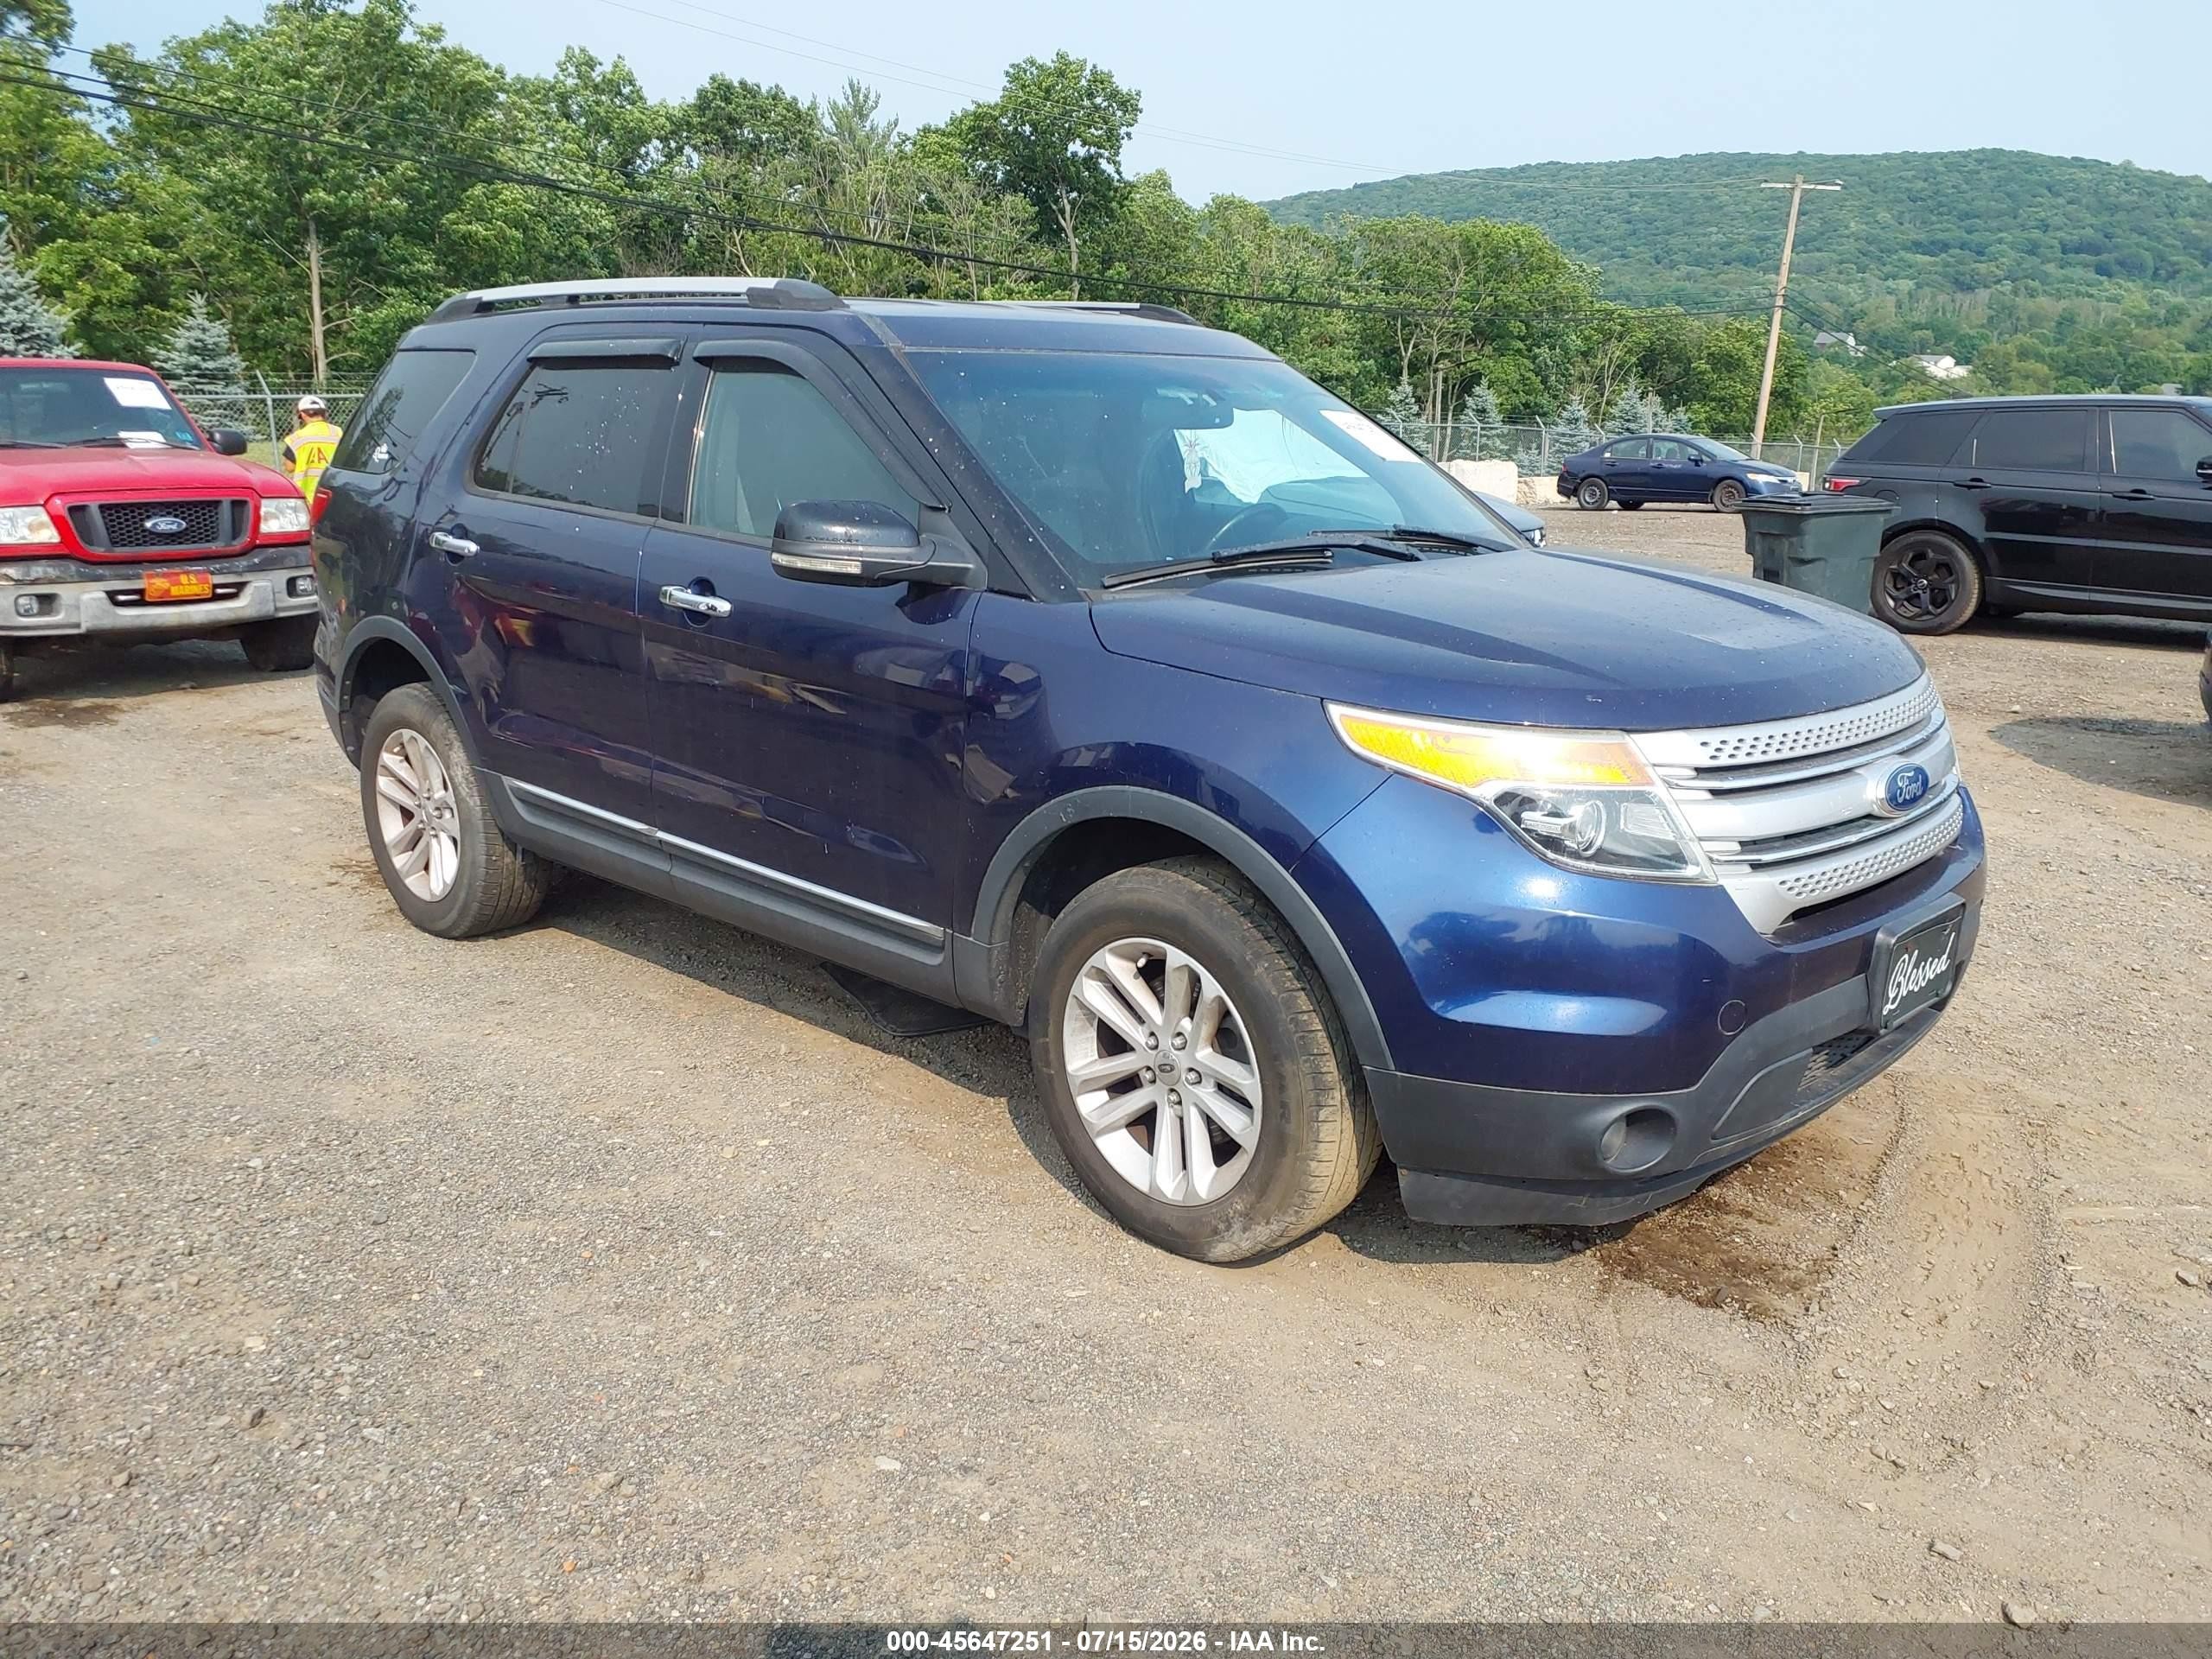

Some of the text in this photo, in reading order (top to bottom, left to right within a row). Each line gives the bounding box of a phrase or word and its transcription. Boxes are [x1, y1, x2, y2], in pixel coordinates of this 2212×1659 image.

[170, 584, 209, 596] MARINES
[1897, 771, 1923, 804] Ford
[1883, 931, 1955, 1015] Blessed
